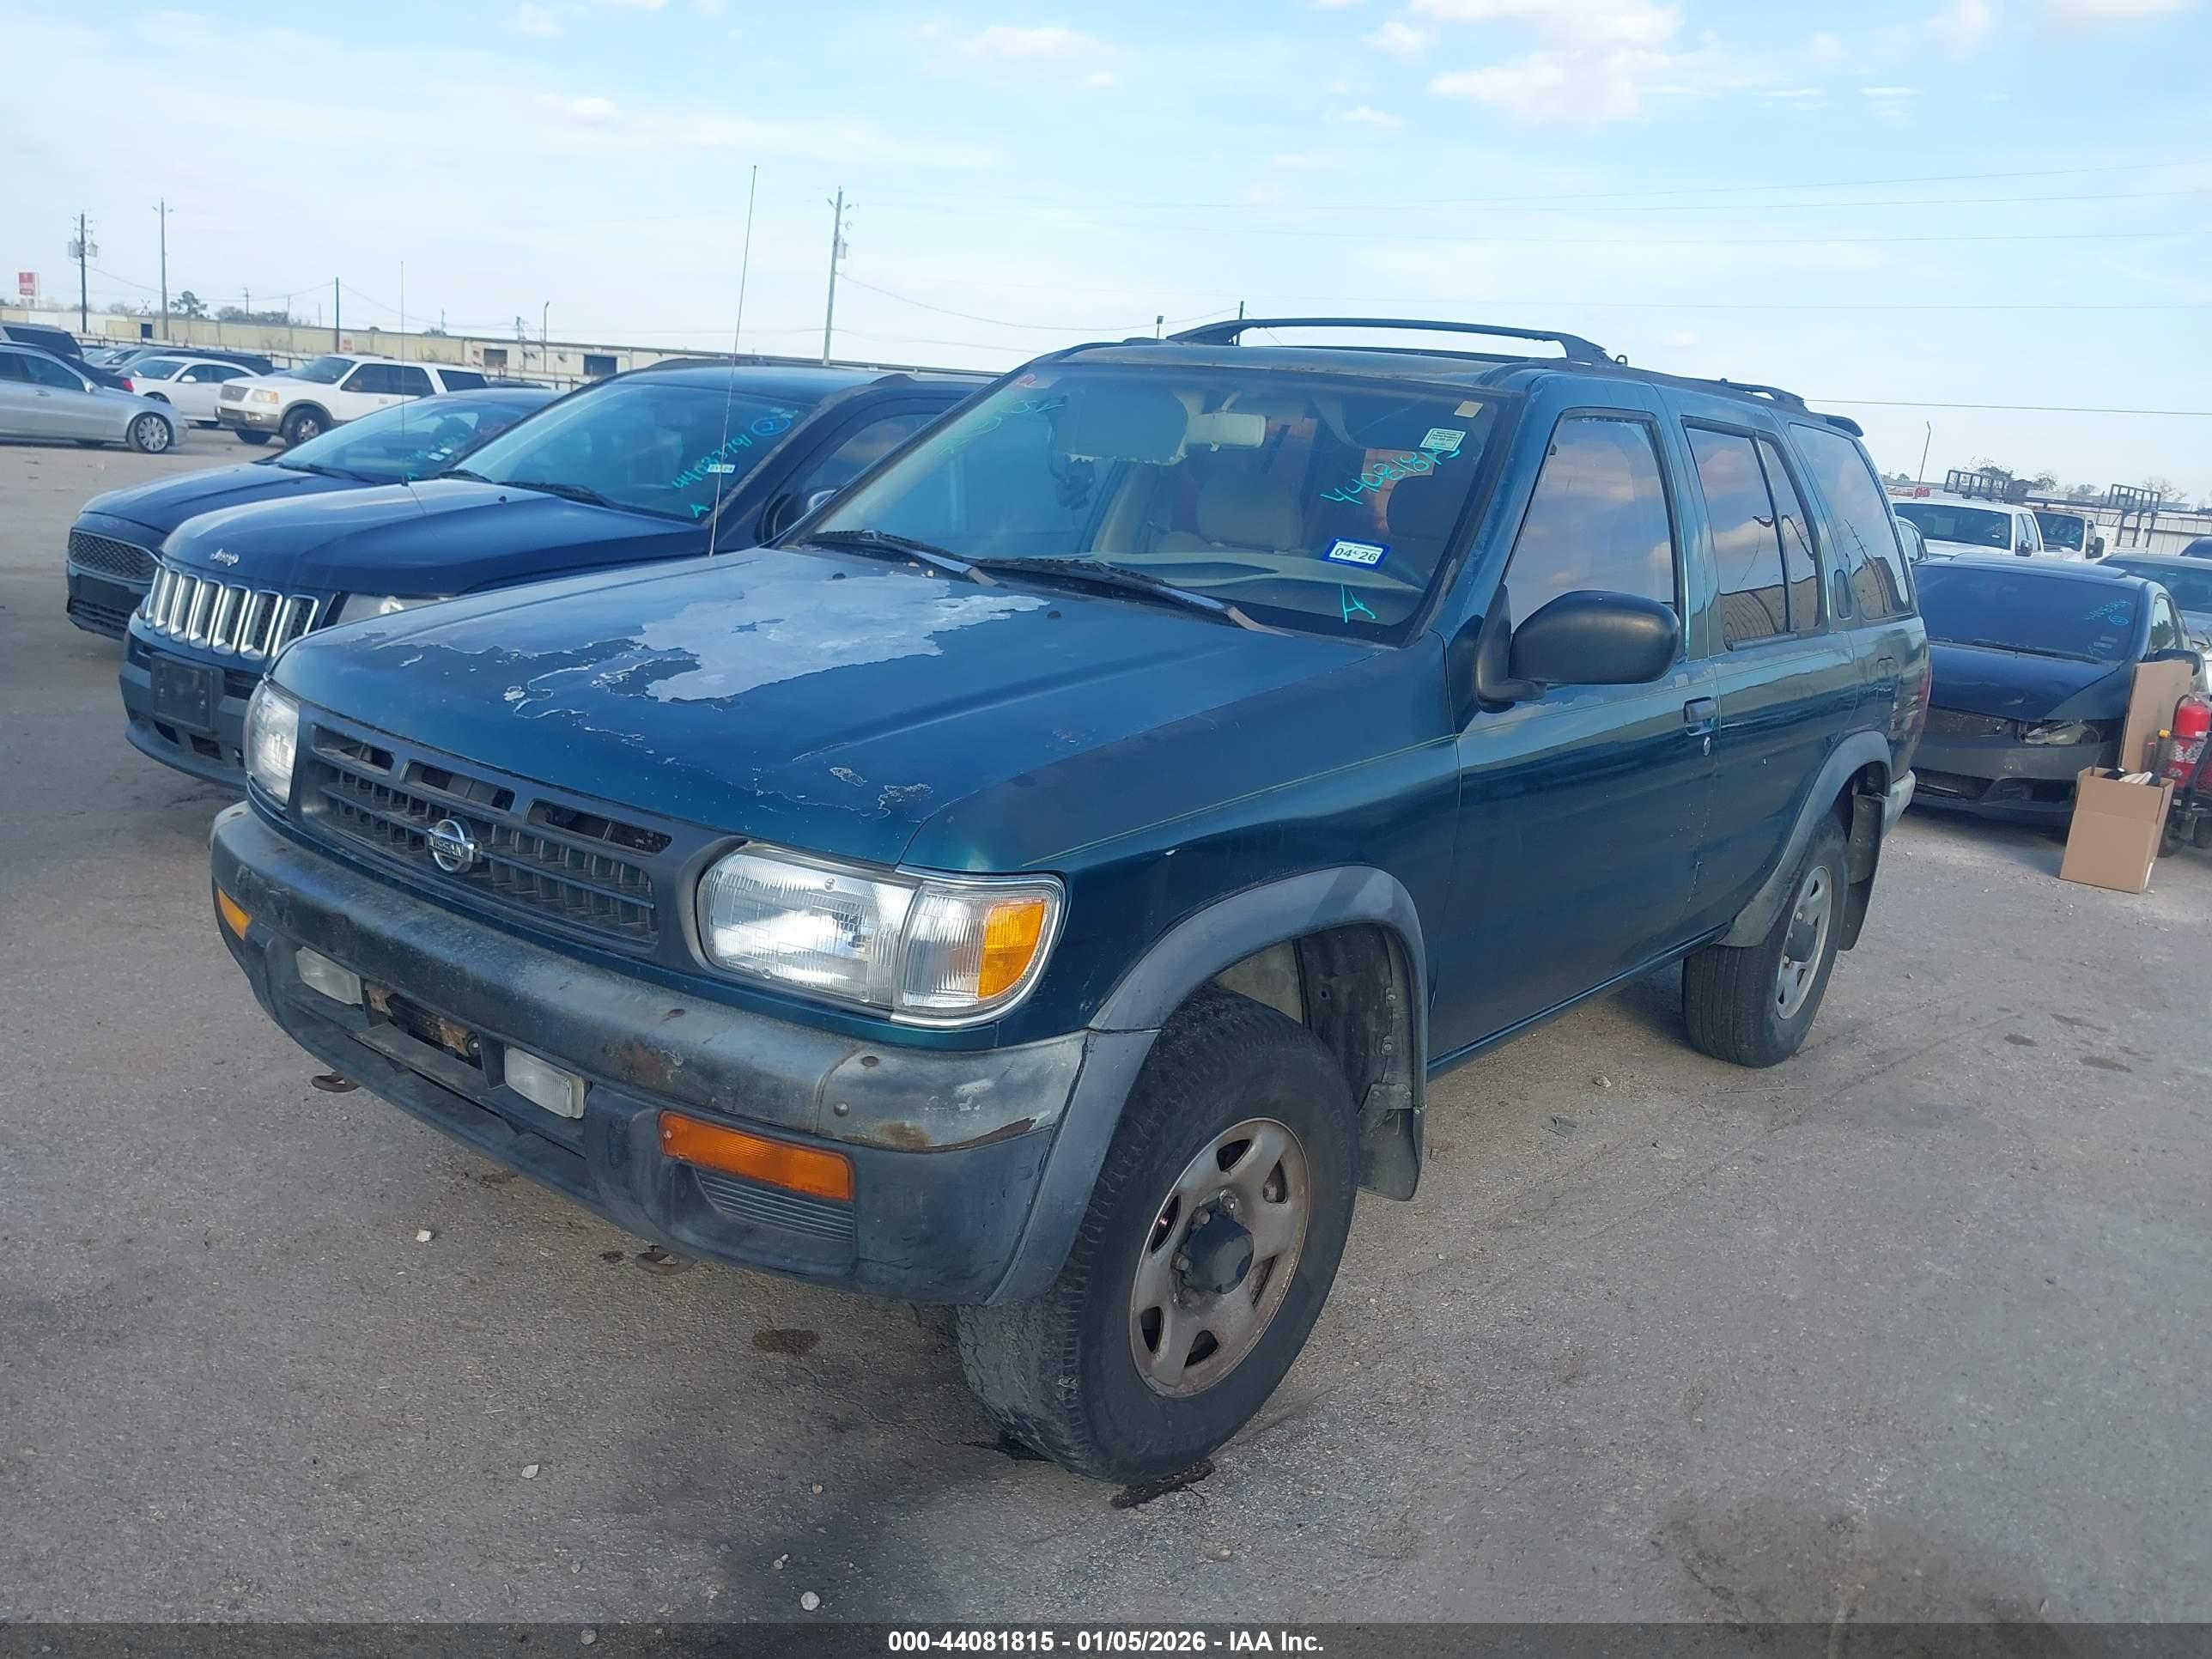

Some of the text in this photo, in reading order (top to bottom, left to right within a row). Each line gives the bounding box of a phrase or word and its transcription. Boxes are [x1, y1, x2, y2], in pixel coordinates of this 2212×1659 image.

[210, 548, 240, 567] Jeep
[1334, 548, 1352, 558] 04
[1358, 551, 1378, 562] 26
[428, 836, 464, 857] NISSAN
